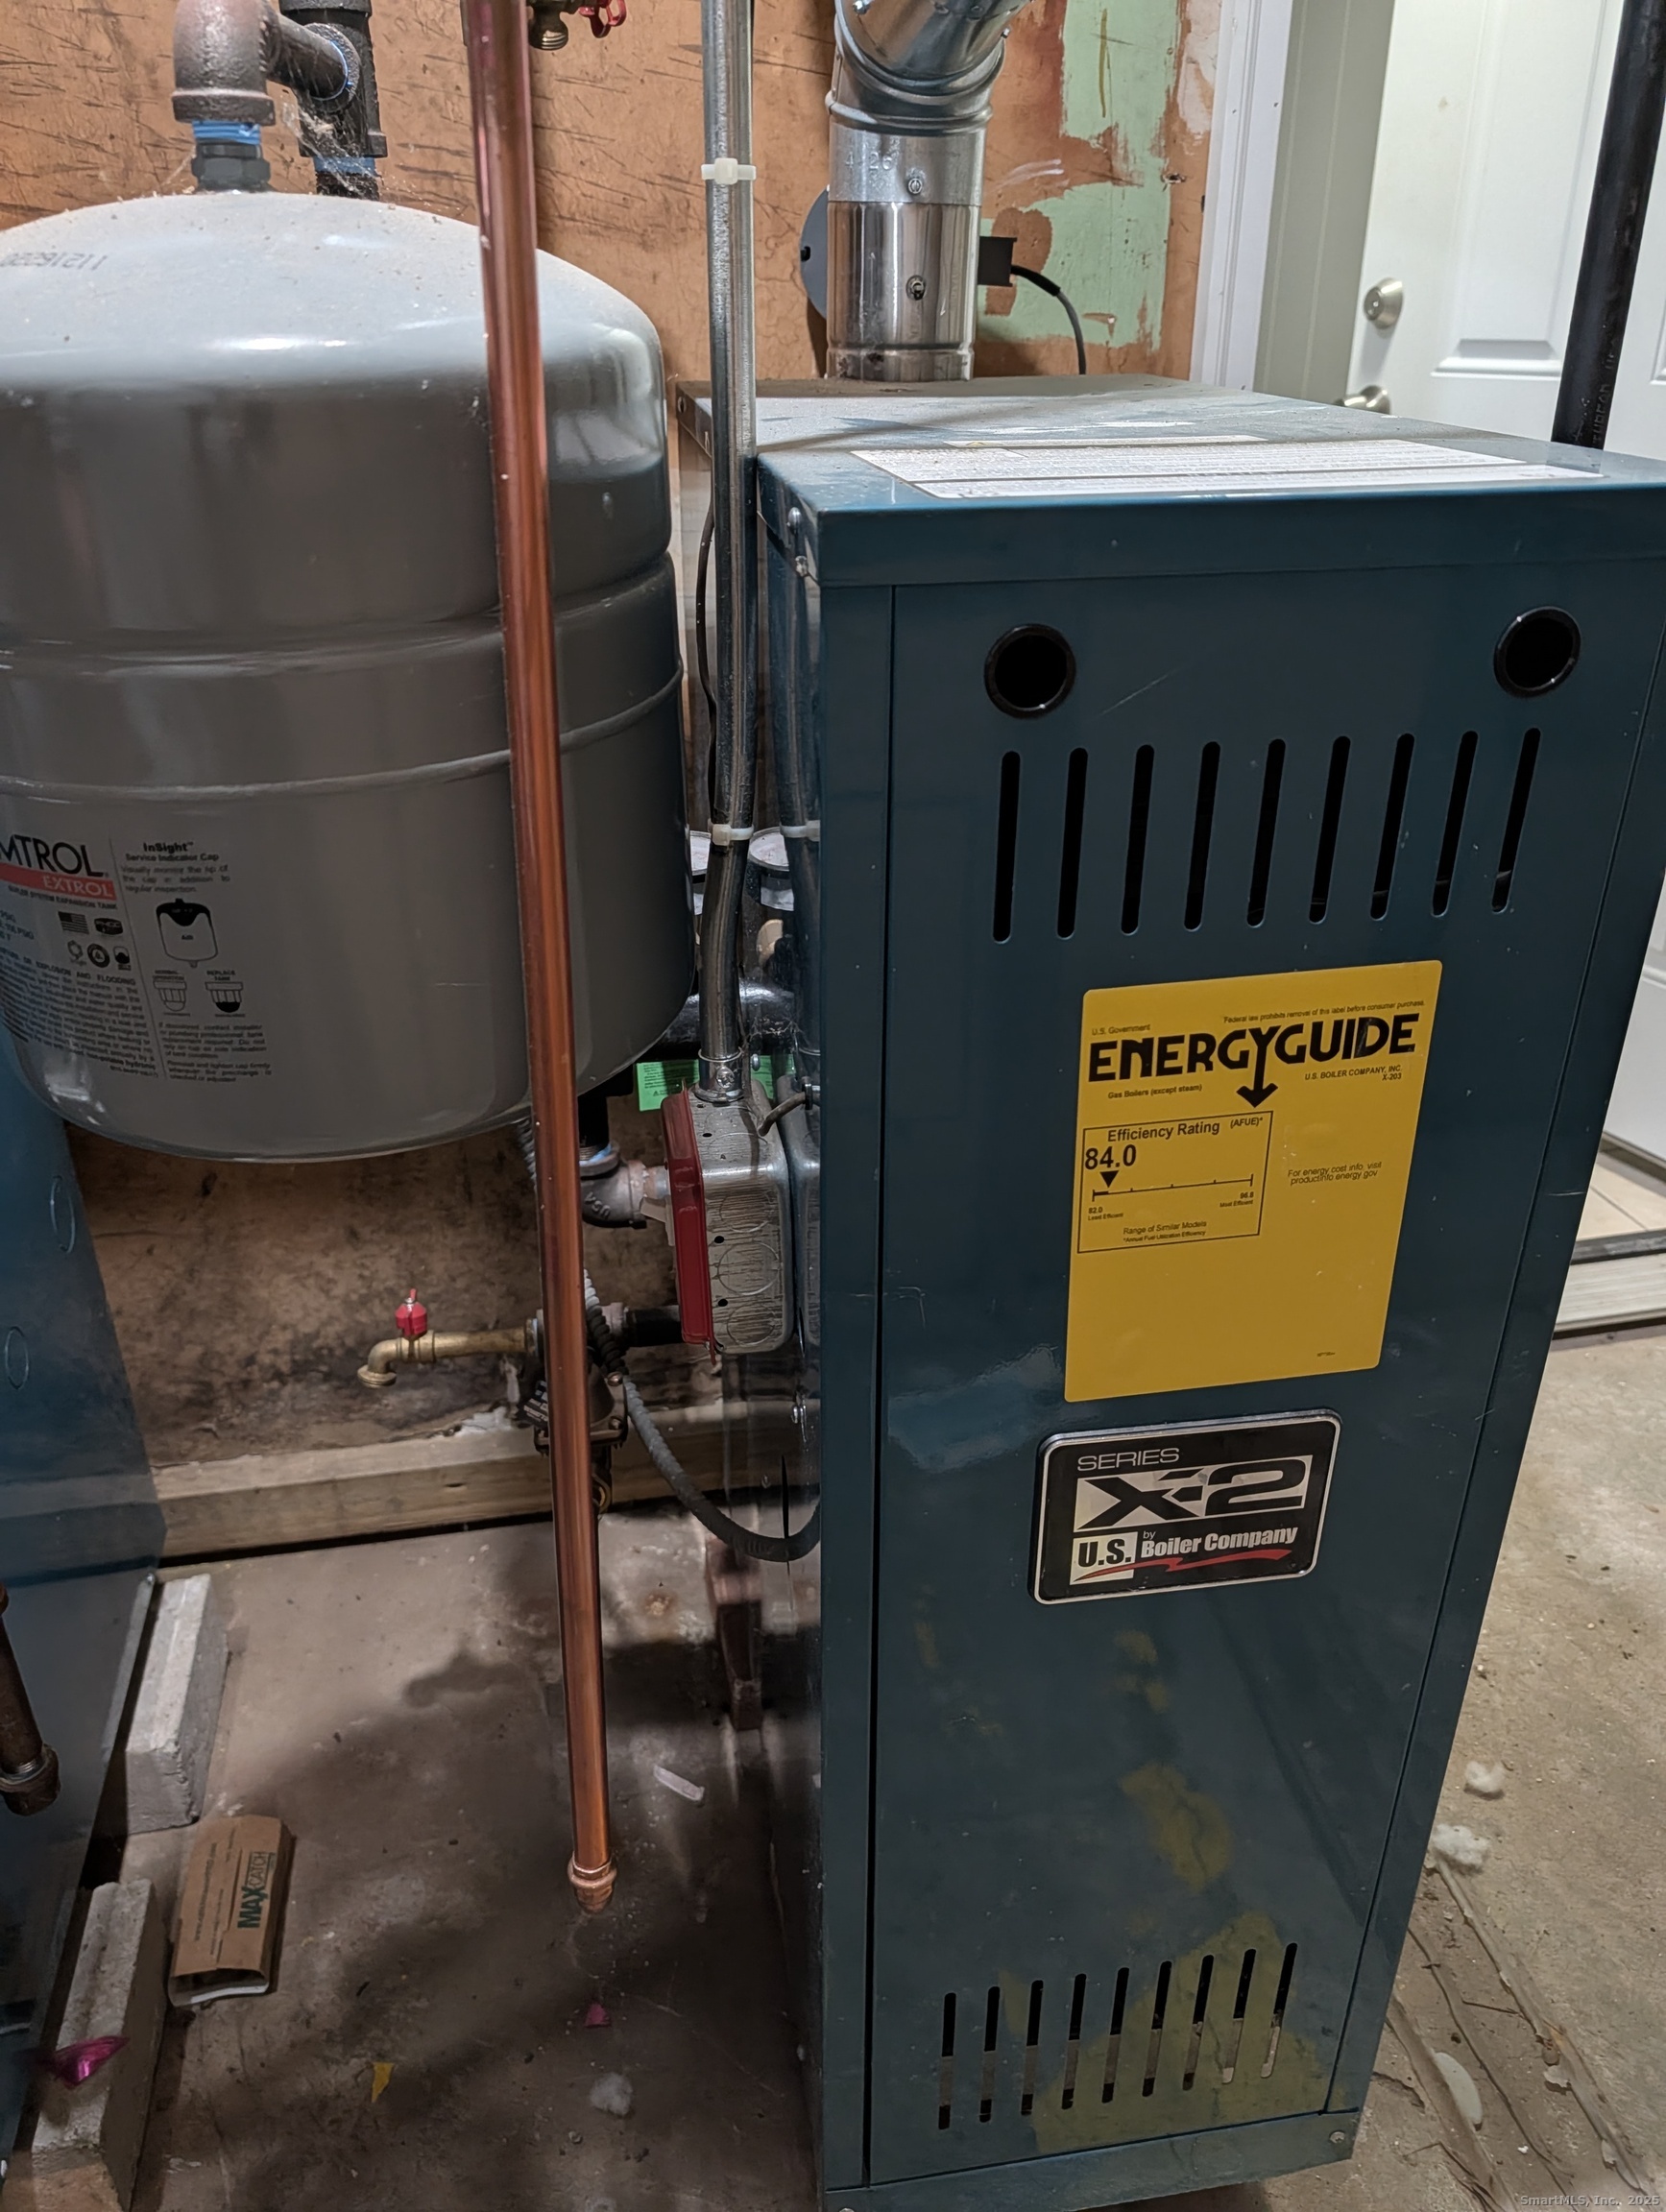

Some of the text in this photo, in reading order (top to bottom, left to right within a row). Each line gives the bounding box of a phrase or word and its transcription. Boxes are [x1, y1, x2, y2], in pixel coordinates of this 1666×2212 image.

[42, 874, 114, 898] EXTROL
[1260, 1011, 1286, 1022] prohibits
[1286, 1009, 1311, 1018] removal
[1332, 1005, 1346, 1014] label
[1346, 1004, 1365, 1013] before
[1366, 1002, 1395, 1011] consumer
[1108, 1023, 1151, 1034] Government
[1320, 1070, 1347, 1079] BOILER
[1382, 1072, 1402, 1081] X-203
[1108, 1084, 1202, 1099] Gas Boilers (except steam)
[1107, 1122, 1173, 1142] Efficiency
[1176, 1120, 1220, 1140] Rating
[1084, 1143, 1137, 1170] 84.0
[1288, 1168, 1301, 1177] For
[1302, 1166, 1330, 1177] energy
[1331, 1165, 1347, 1173] cost
[1367, 1161, 1383, 1169] visit
[1088, 1206, 1103, 1214] 82.0
[1233, 1199, 1254, 1208] Efficient
[1123, 1220, 1207, 1236] Range of Similar Models
[1182, 1230, 1206, 1238] Efficiency
[1076, 1447, 1180, 1472] SERIES
[1143, 1530, 1156, 1540] by
[1077, 1527, 1298, 1567] U.S. Boiler Company
